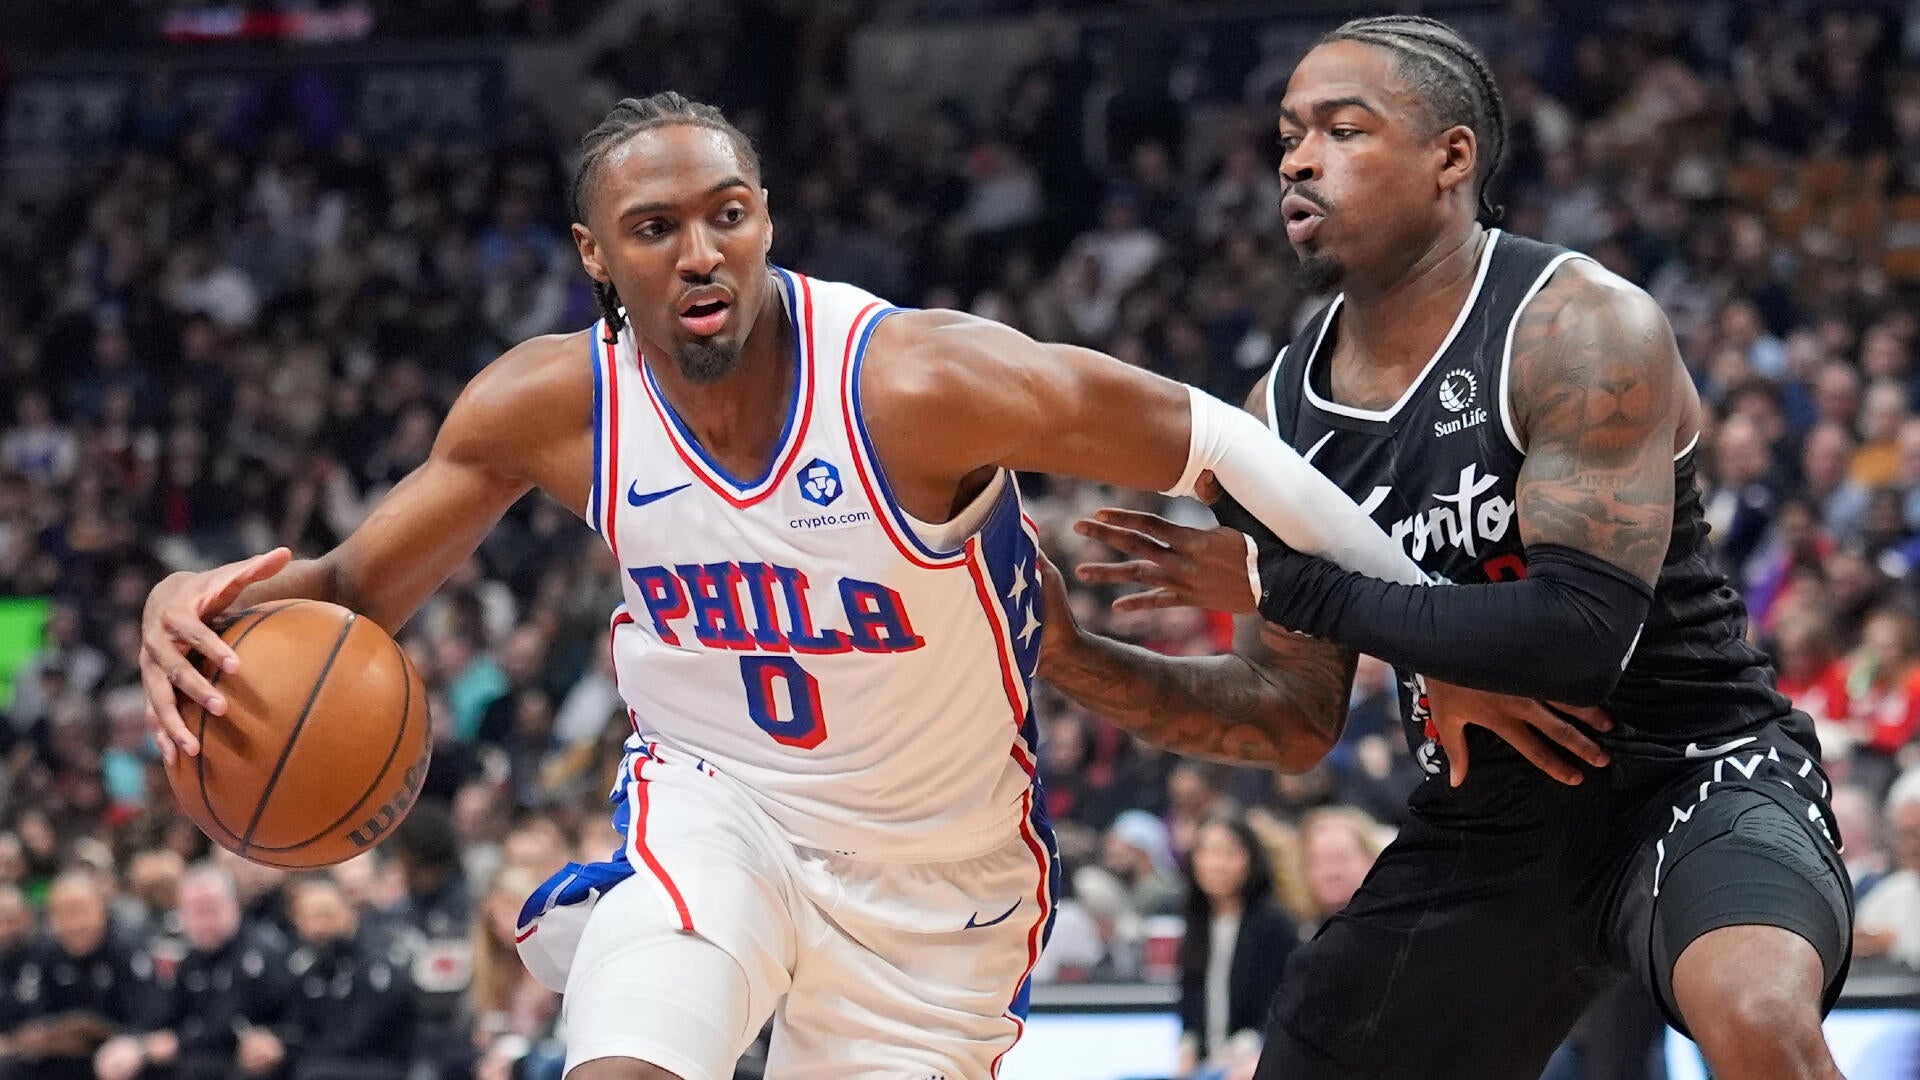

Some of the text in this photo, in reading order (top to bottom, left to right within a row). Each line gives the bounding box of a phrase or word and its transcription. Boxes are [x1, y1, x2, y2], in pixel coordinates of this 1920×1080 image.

[1434, 407, 1487, 438] Sun Life
[790, 511, 870, 528] crypto.com
[1359, 462, 1516, 562] ronto
[627, 560, 926, 655] PHILA
[739, 656, 828, 750] 0
